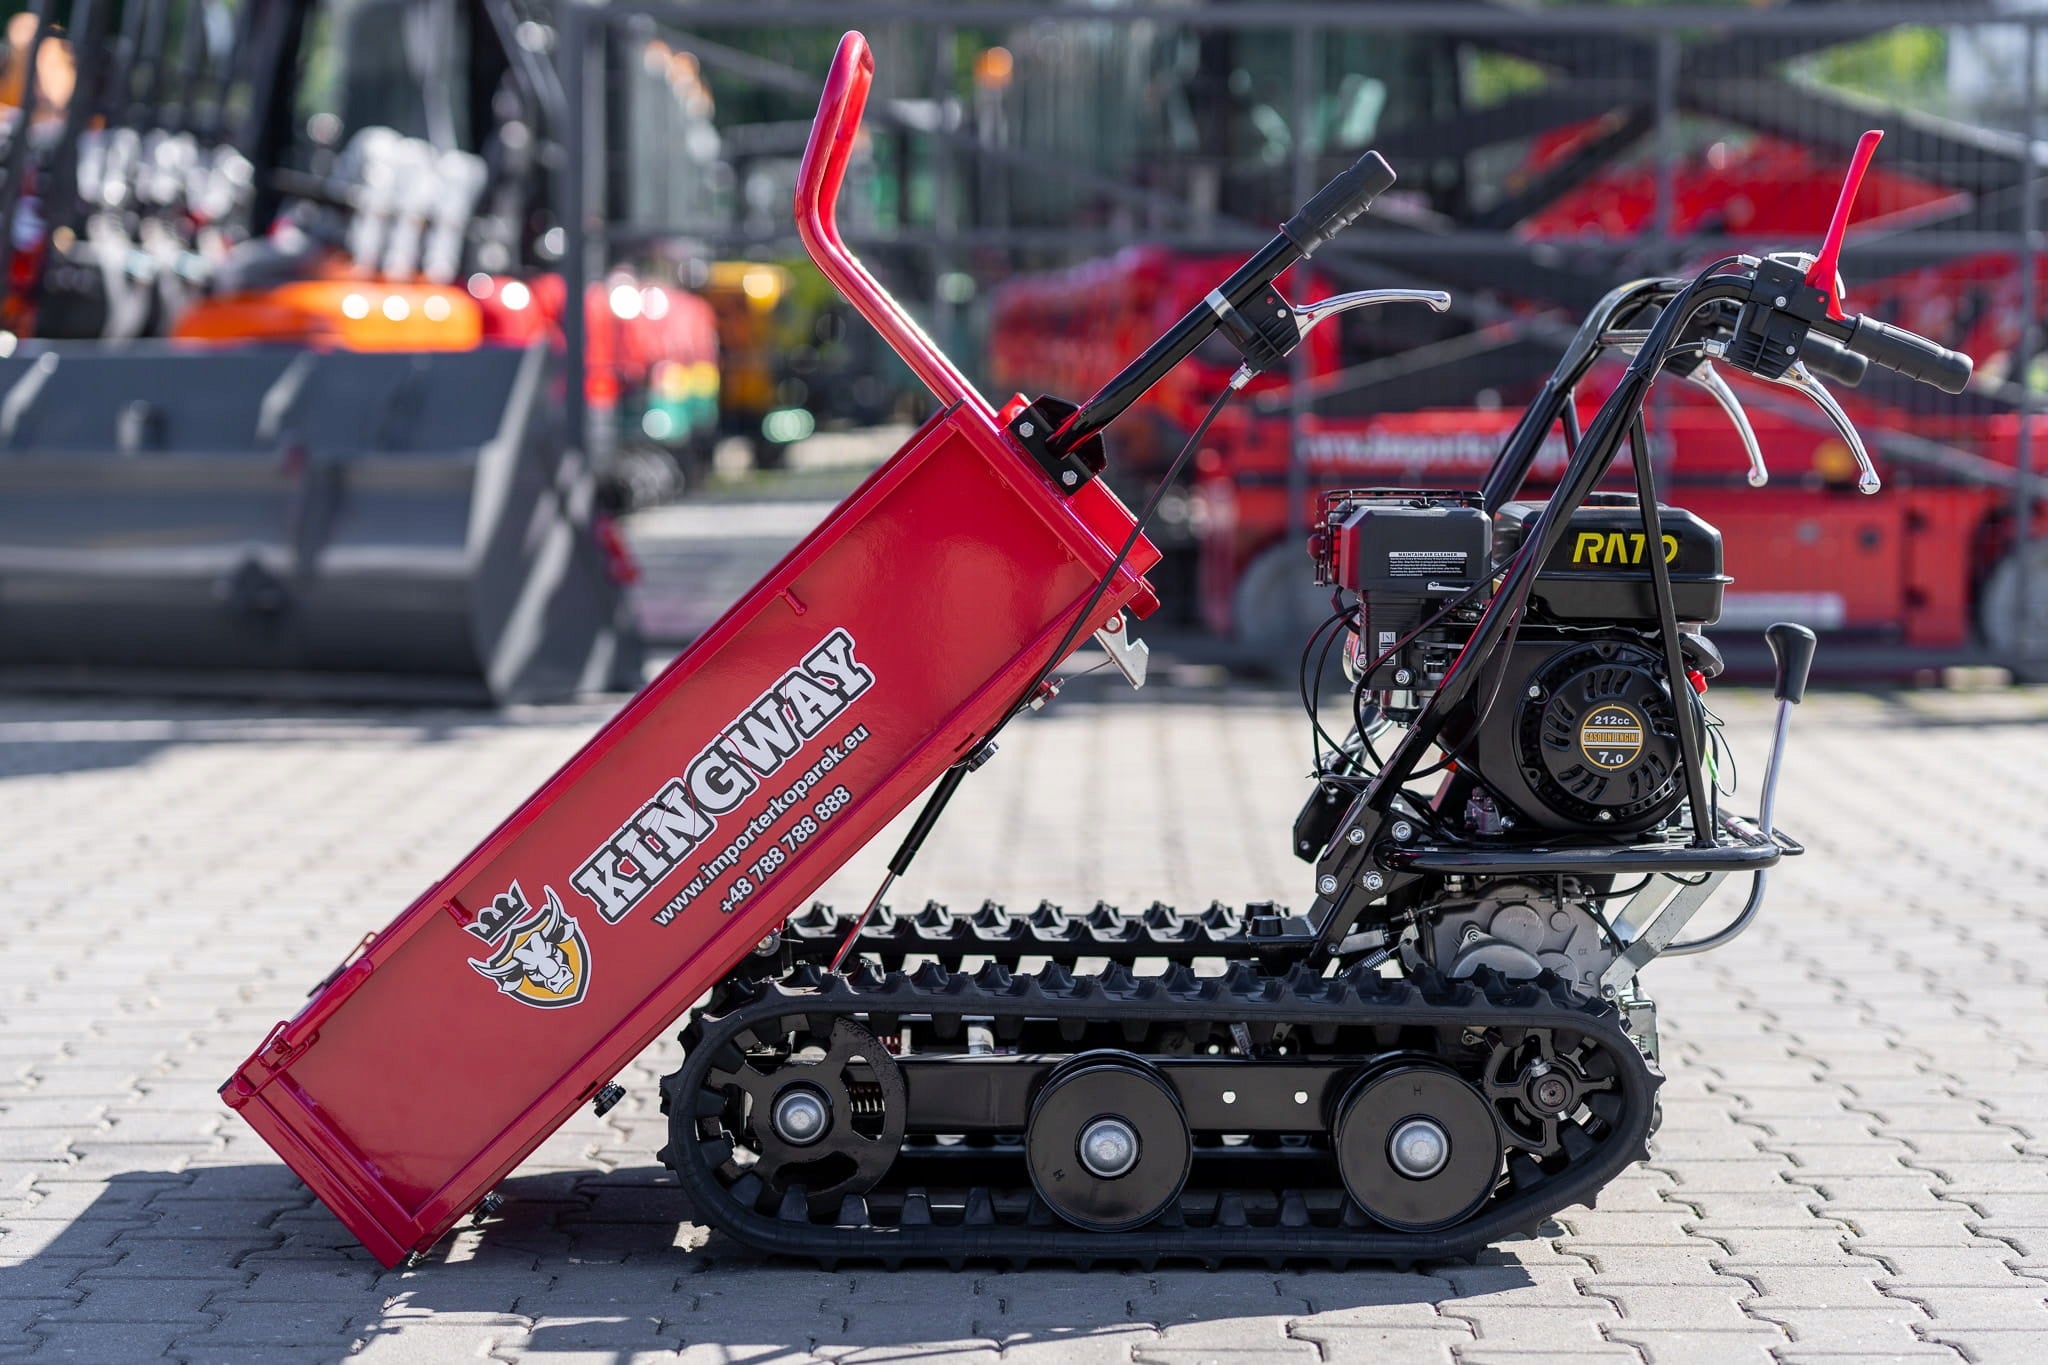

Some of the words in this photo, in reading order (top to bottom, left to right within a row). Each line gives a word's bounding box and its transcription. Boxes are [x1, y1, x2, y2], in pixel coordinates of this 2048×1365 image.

[1585, 732, 1615, 742] GASOLINE
[1617, 732, 1639, 743] ENGINE
[1594, 715, 1630, 725] 212cc
[572, 629, 874, 923] KINGWAY
[1599, 751, 1623, 764] 7.0
[653, 724, 870, 926] www.importerkoparek.eu
[721, 877, 754, 912] +48
[748, 847, 786, 883] 788
[780, 815, 818, 852] 788
[814, 784, 852, 822] 888
